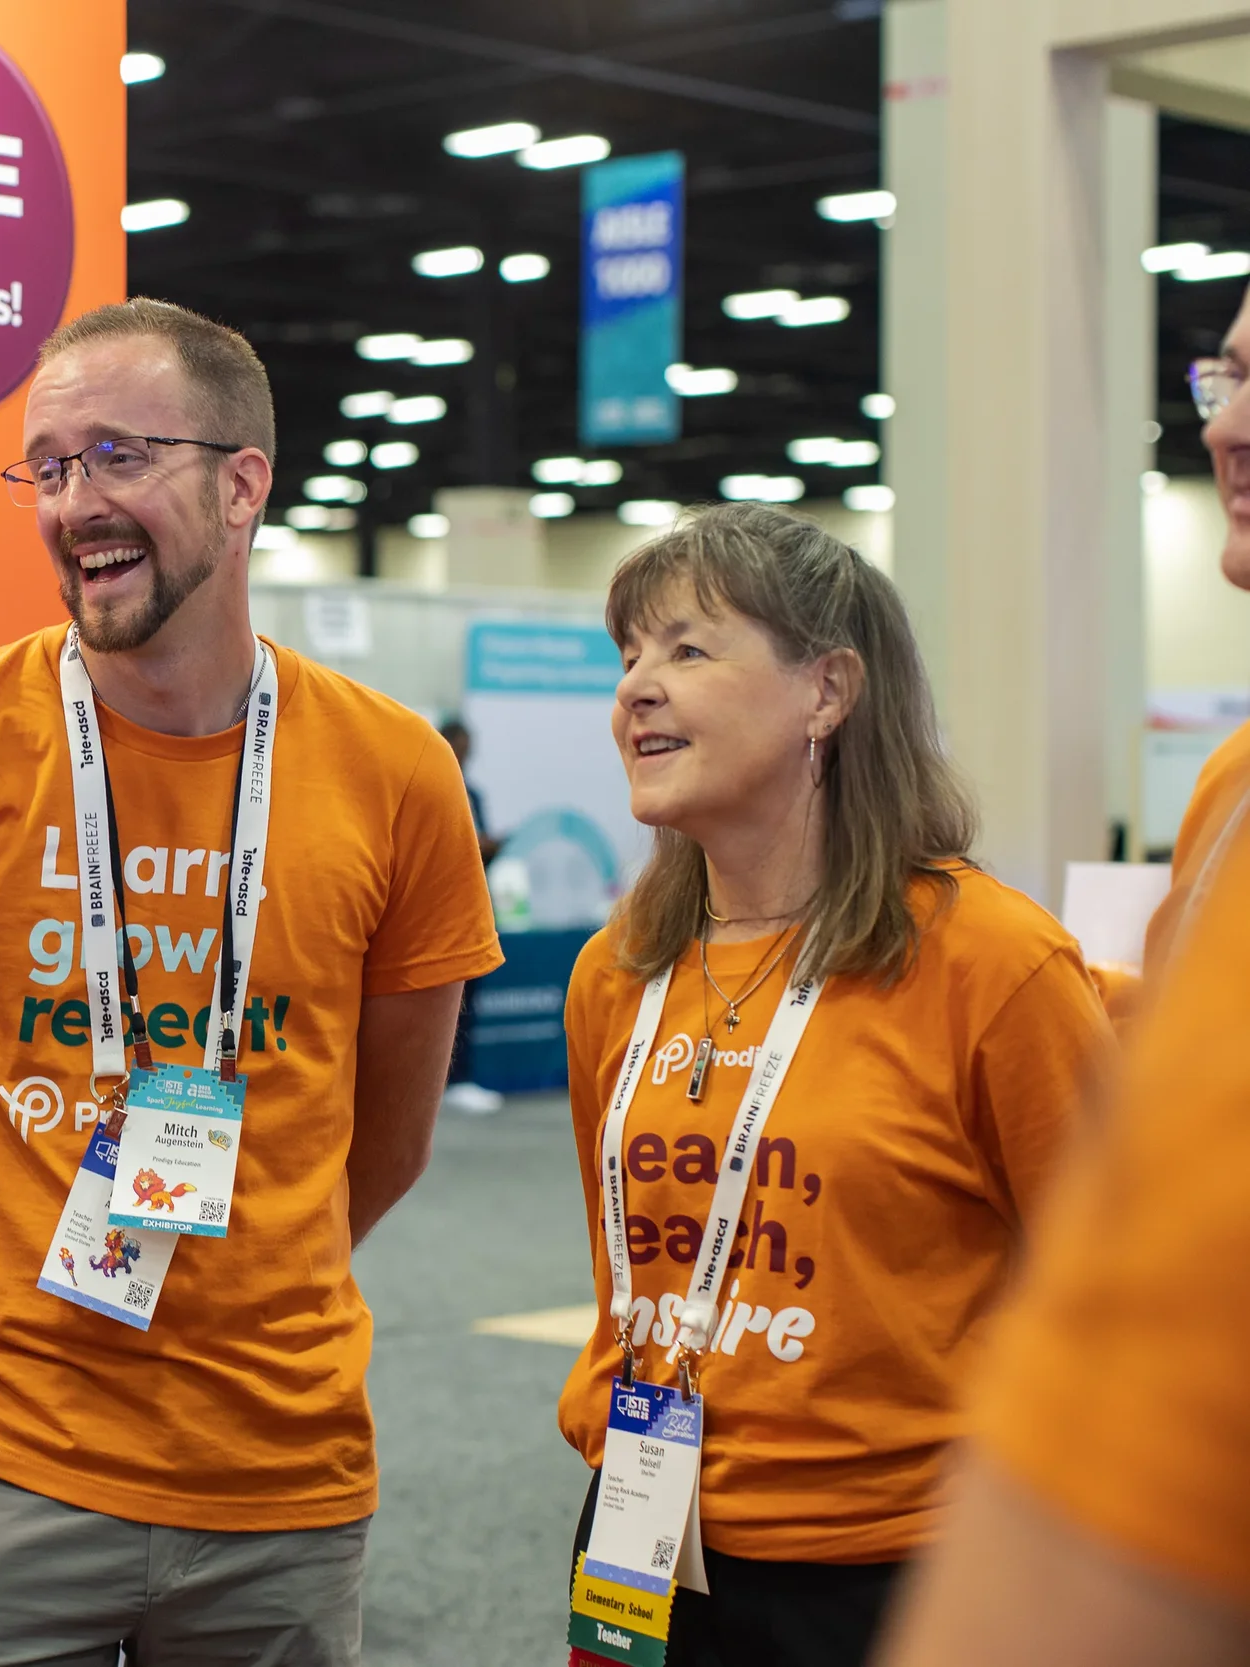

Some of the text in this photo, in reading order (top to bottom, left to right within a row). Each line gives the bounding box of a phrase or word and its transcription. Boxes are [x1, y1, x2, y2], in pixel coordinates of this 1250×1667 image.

[80, 700, 95, 770] iste+ascd
[250, 709, 270, 804] BRAINFREEZE
[84, 812, 104, 911] BRAINFREEZE
[235, 847, 258, 917] iste+ascd
[99, 971, 114, 1043] iste+ascd
[19, 996, 290, 1052] reet!
[165, 1080, 184, 1090] ISTE
[146, 1096, 224, 1114] Spark Joyful Learning
[735, 1050, 783, 1154] BRAINFREEZE
[164, 1123, 198, 1138] Mitch
[155, 1135, 204, 1149] Augenstein
[152, 1156, 201, 1168] Prodigy Education
[70, 1219, 90, 1231] Prodigy
[73, 1210, 92, 1223] Teacher
[142, 1219, 193, 1232] EXHIBITOR
[609, 1175, 624, 1281] BRAINFREEZE
[698, 1217, 729, 1292] iste+ascd
[628, 1395, 650, 1412] ISTE
[639, 1440, 665, 1457] Susan
[639, 1457, 661, 1470] Halsell
[606, 1484, 650, 1501] Living Rock Academy
[585, 1589, 654, 1621] Elementary School
[596, 1622, 632, 1651] Teacher
